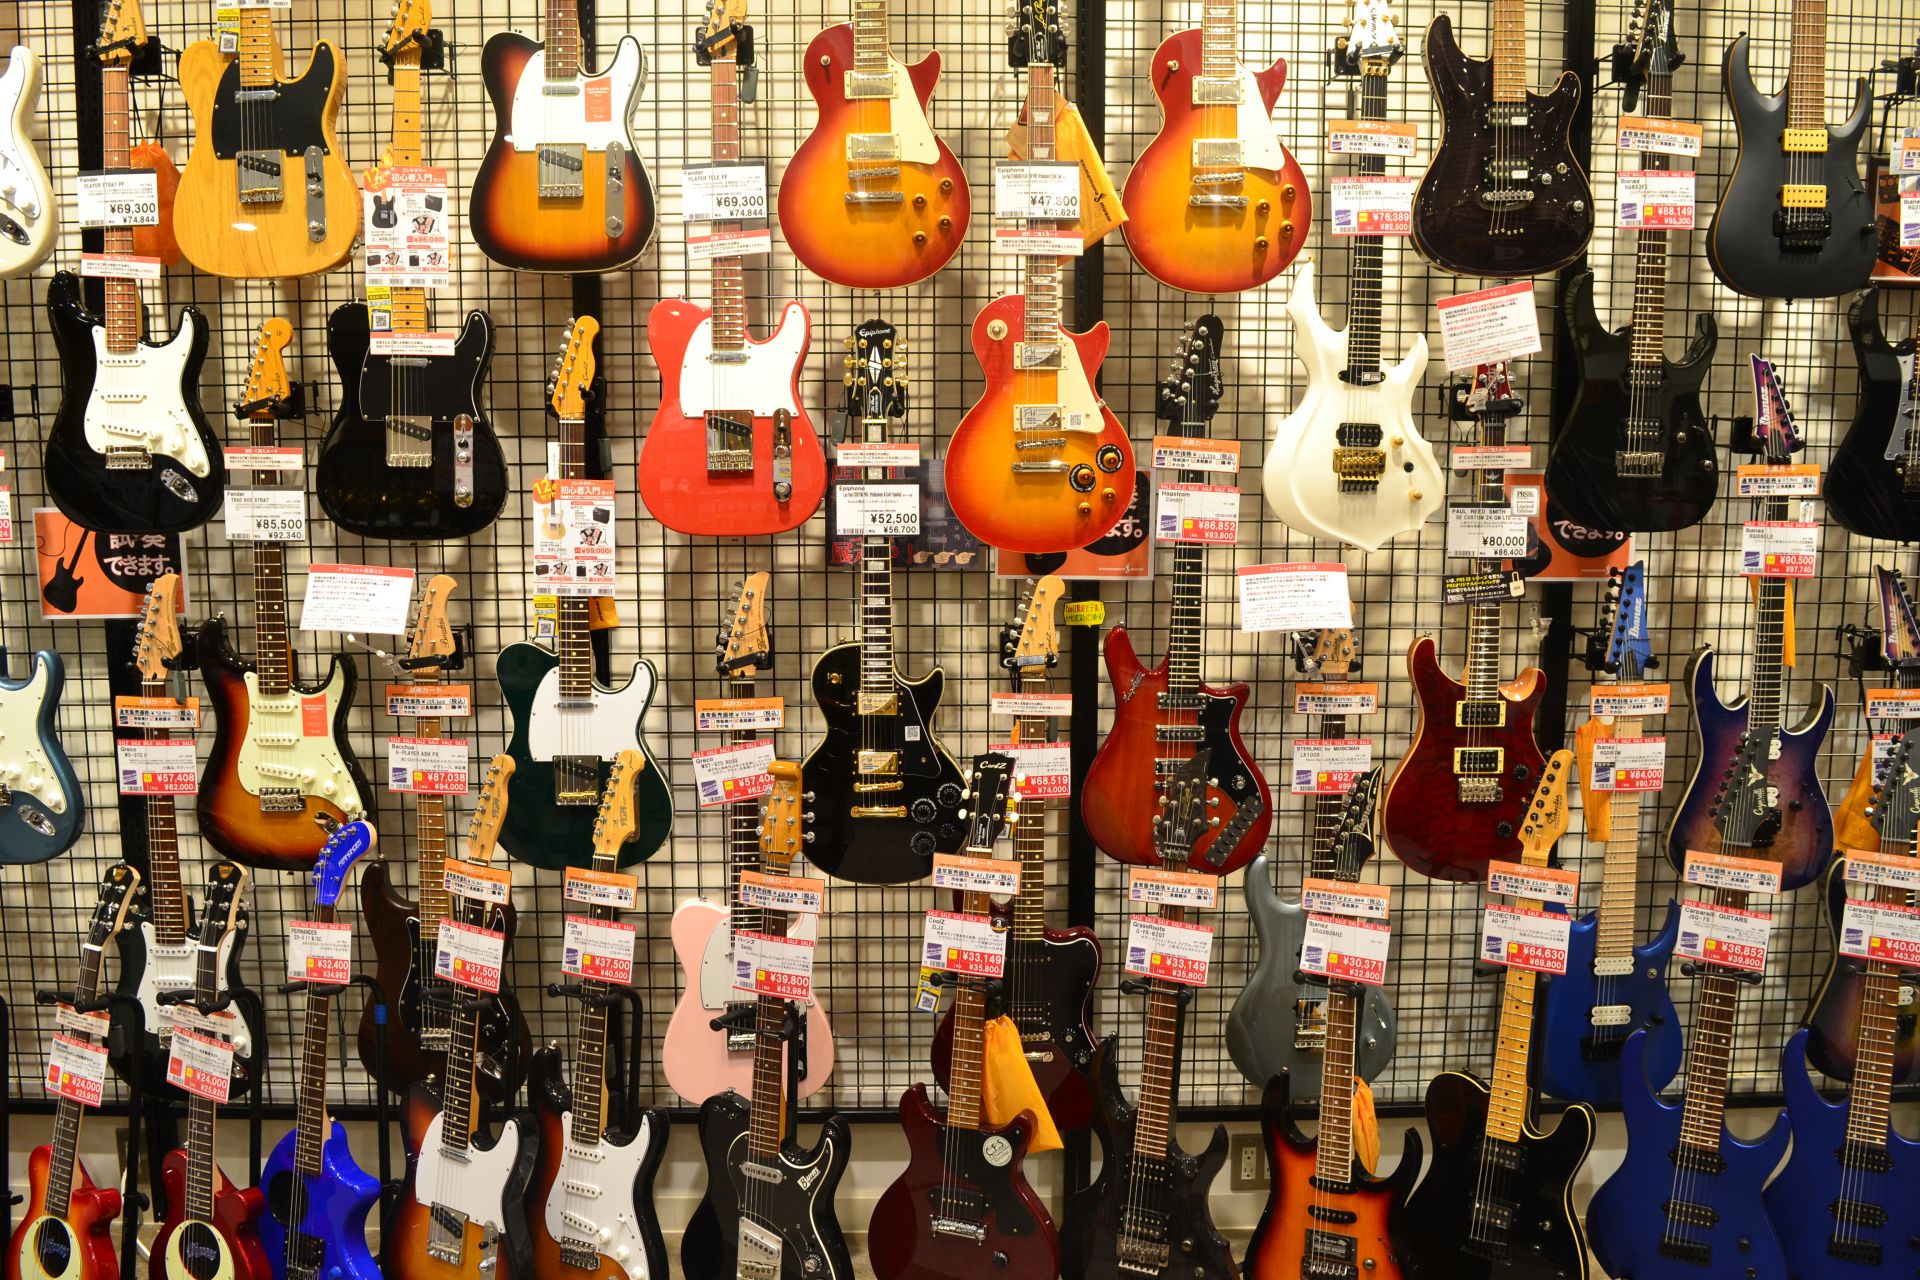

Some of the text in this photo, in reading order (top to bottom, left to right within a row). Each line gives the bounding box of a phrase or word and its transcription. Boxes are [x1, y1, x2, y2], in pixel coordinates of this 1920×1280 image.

[391, 173, 433, 183] 初心者入門
[716, 196, 764, 207] ¥69,300
[110, 203, 156, 215] ¥69,300
[729, 209, 763, 217] ¥74,844
[1657, 206, 1692, 215] ¥88,149
[123, 216, 155, 225] ¥74,844
[1372, 213, 1408, 222] ¥76,389
[858, 328, 891, 338] Epiphone
[560, 486, 601, 496] 初心者入門
[1161, 491, 1191, 499] Hagstrom
[1451, 508, 1469, 516] PAUL
[255, 519, 303, 530] ¥85,500
[870, 513, 918, 525] ¥52,500
[883, 526, 917, 534] ¥56,700
[1198, 521, 1236, 532] ¥86,852
[268, 532, 302, 540] ¥92,340
[1204, 532, 1234, 541] ¥93,800
[1481, 536, 1525, 547] ¥80,000
[1493, 549, 1524, 557] ¥86,400
[103, 554, 175, 577] できます。
[1779, 556, 1814, 565] ¥90,500
[1628, 597, 1643, 640] Ibanez
[391, 744, 415, 752] Bacchus
[695, 756, 714, 765] Greco
[979, 760, 1006, 770] CoolZ
[156, 773, 195, 783] ¥57,408
[427, 773, 466, 783] ¥87,038
[1630, 770, 1663, 780] ¥84,000
[1030, 776, 1068, 786] ¥68,519
[928, 917, 945, 925] CoolZ
[1488, 911, 1521, 922] SCHECTER
[1718, 913, 1748, 924] GUITARS
[996, 919, 1002, 927] 3
[1132, 922, 1166, 933] GrassRoots
[291, 928, 318, 936] FERNANDES
[1522, 945, 1566, 961] ¥64,630
[1721, 942, 1764, 959] ¥36,852
[962, 952, 1002, 964] ¥33,149
[317, 959, 349, 970] ¥32,400
[594, 958, 630, 970] ¥37,500
[968, 963, 1001, 974] ¥35,800
[1165, 957, 1206, 973] ¥33,149
[1342, 956, 1382, 972] ¥30,371
[465, 963, 499, 980] ¥37,500
[1172, 968, 1204, 982] ¥35,800
[770, 973, 809, 987] ¥39,800
[777, 985, 807, 996] ¥42,984
[71, 1076, 101, 1094] ¥24,000
[196, 1070, 228, 1090] ¥24,000
